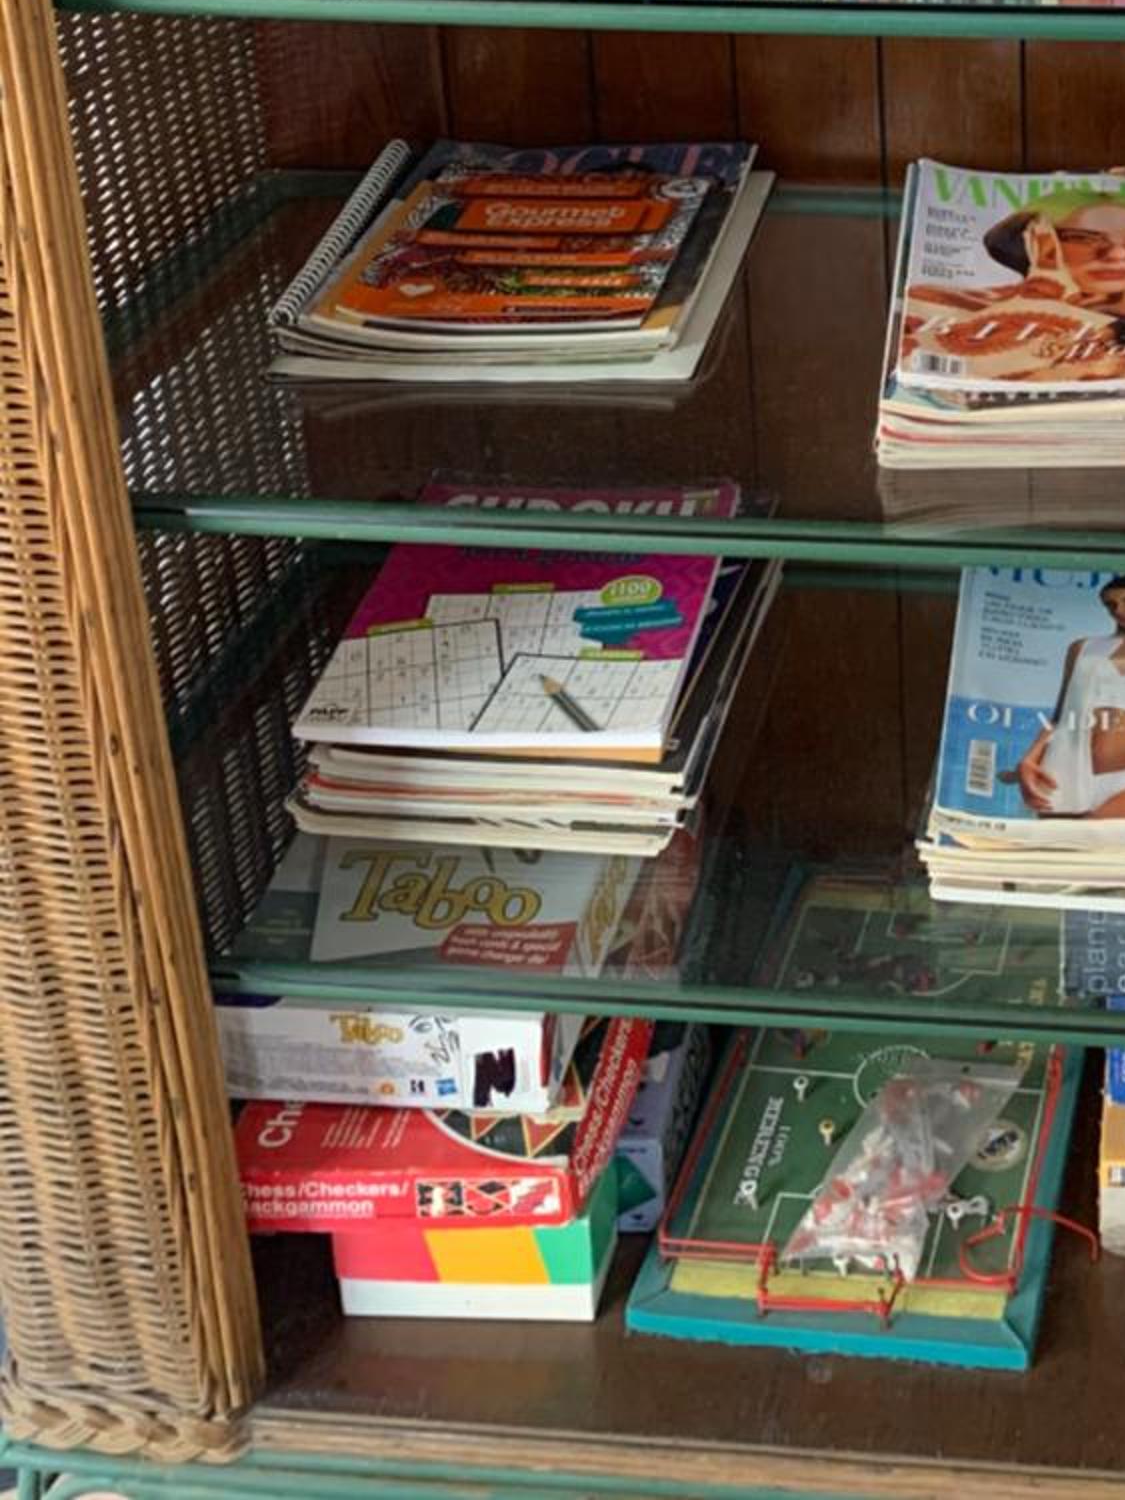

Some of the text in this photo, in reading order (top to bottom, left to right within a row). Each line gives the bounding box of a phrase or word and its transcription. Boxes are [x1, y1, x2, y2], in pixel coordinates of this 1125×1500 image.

[486, 201, 626, 221] Gourmet
[487, 212, 613, 231] Express
[339, 849, 543, 931] Taboo
[331, 1013, 404, 1047] Taboo
[241, 1180, 409, 1199] hess/Checkers/
[244, 1198, 375, 1218] ackgammon
